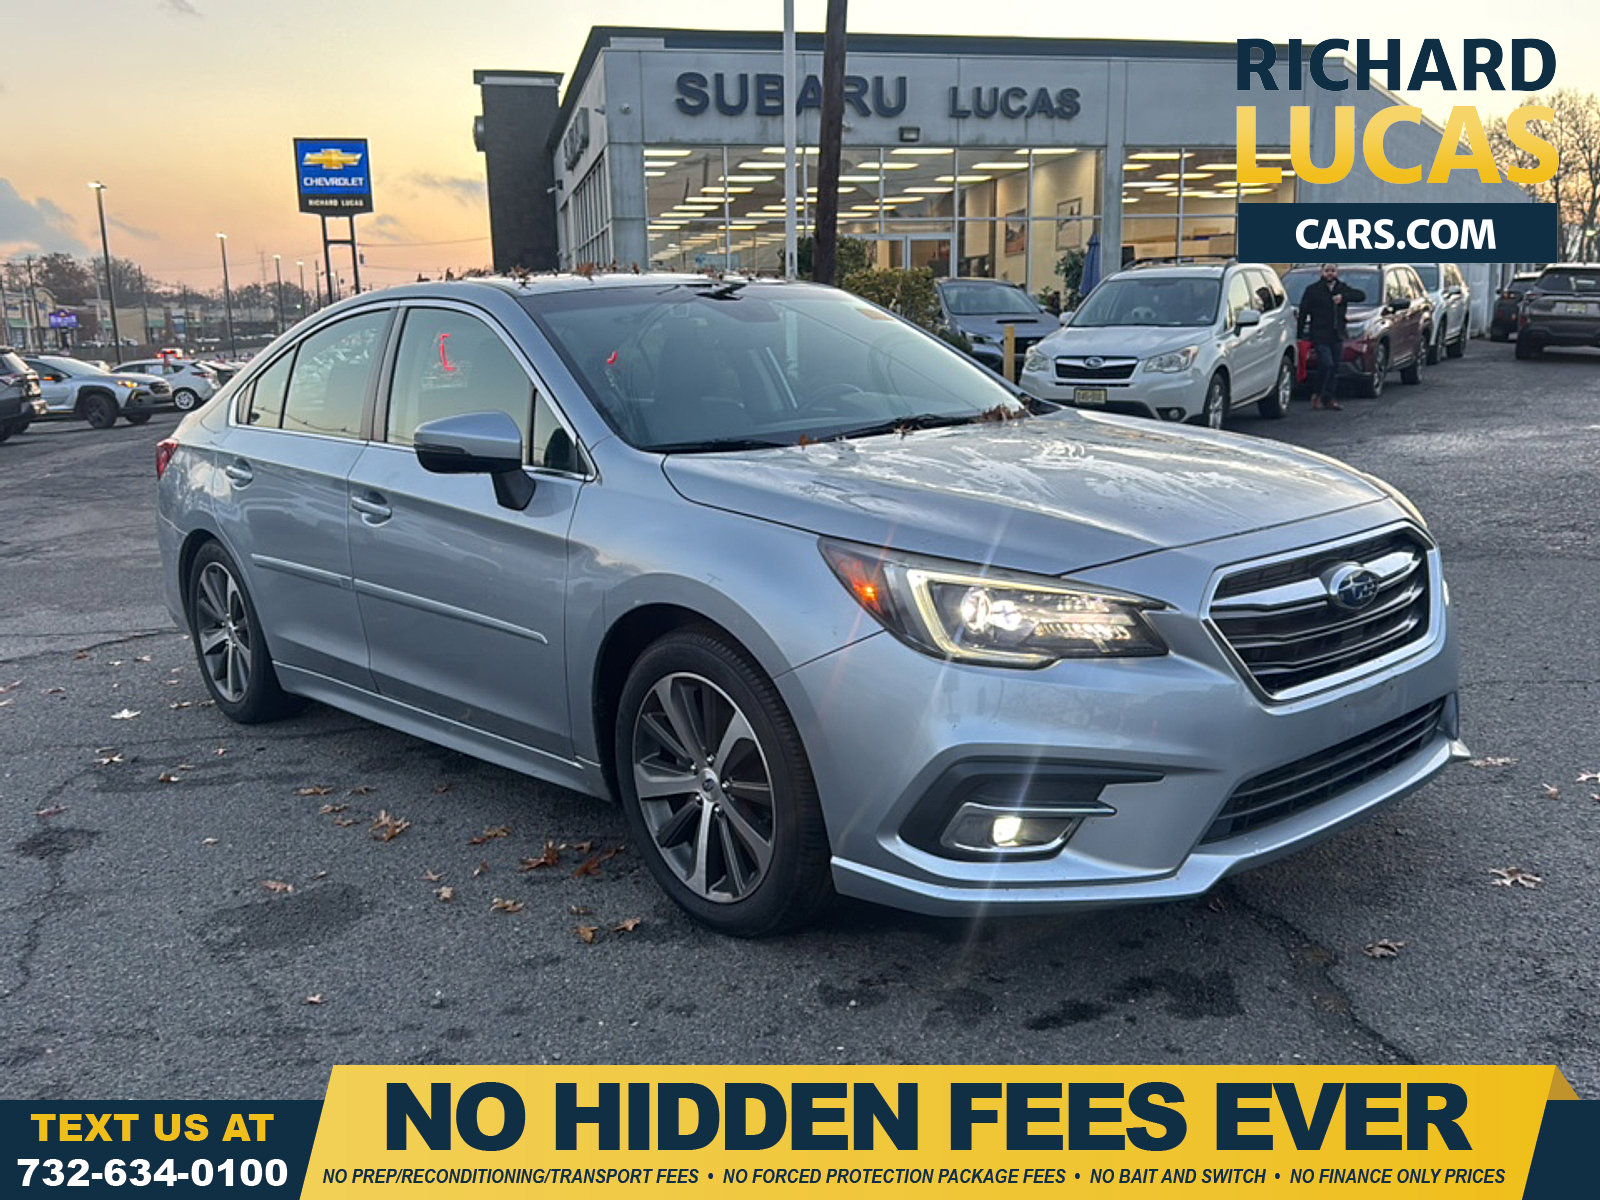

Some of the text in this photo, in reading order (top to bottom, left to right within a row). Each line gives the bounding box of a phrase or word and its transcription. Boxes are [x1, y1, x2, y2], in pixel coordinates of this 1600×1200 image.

[676, 72, 1081, 119] SUBARU LUCAS
[303, 177, 364, 187] CHEVROLET
